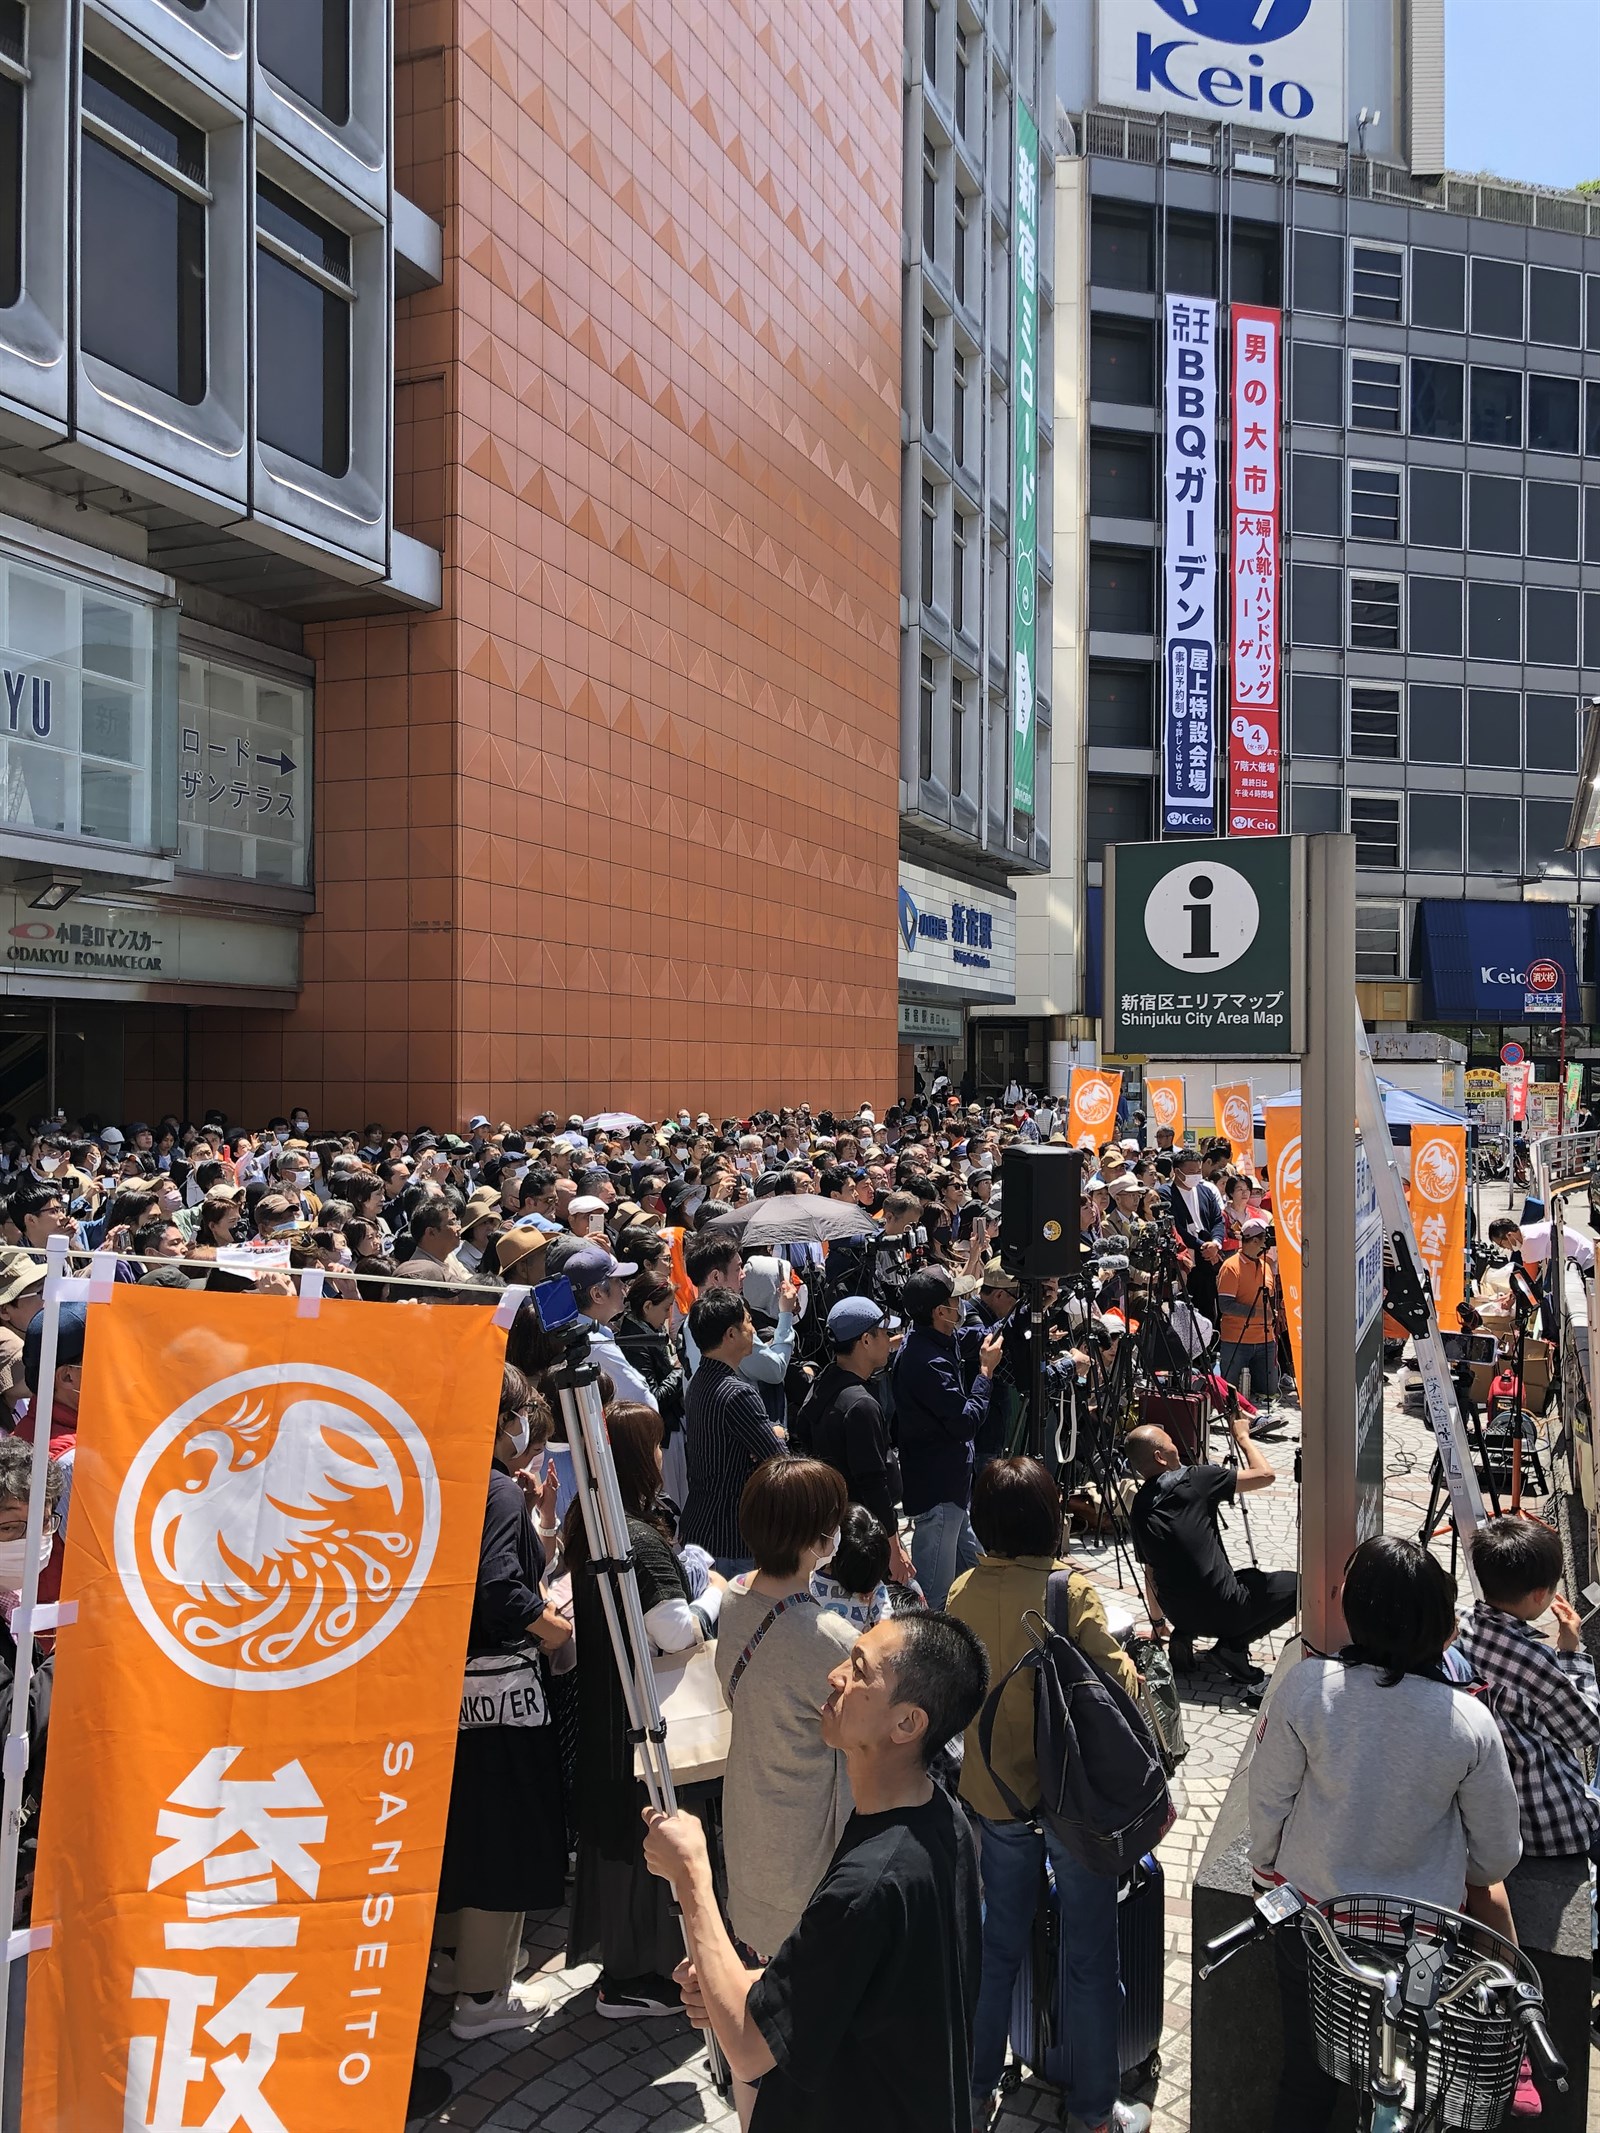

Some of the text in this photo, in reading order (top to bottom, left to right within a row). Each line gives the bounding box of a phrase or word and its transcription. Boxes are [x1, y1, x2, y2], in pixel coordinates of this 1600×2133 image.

[1136, 32, 1314, 119] Keio
[1018, 145, 1036, 522] 新宿ミロード
[1243, 333, 1268, 495] 男の大市
[1172, 303, 1210, 632] 京王BBQガーデン
[1238, 516, 1255, 698] 大バーゲン
[1256, 517, 1273, 700] 婦人靴・ハンドバッグ
[3, 668, 51, 738] YU
[1188, 648, 1209, 793] 屋上特設会場
[1236, 720, 1244, 732] 5
[1251, 729, 1261, 743] 4
[182, 727, 251, 767] ロード
[1234, 760, 1276, 774] 7階大催場
[1266, 748, 1278, 756] まで
[180, 769, 296, 819] ザンテラス
[1182, 813, 1212, 826] Keio
[1247, 817, 1276, 831] Keio
[55, 922, 163, 952] 小田急ロマンスカー
[952, 903, 993, 949] 新宿駅
[7, 945, 163, 971] ODAKYU ROMANCECAR
[1481, 966, 1529, 984] Keio
[1532, 971, 1555, 983] 消火栓
[1121, 991, 1284, 1012] 新宿区エリアマップ
[1121, 1011, 1284, 1028] Shinjuku City Area Map
[336, 1739, 415, 2087] SANSEITO
[122, 1746, 328, 2133] 参政
